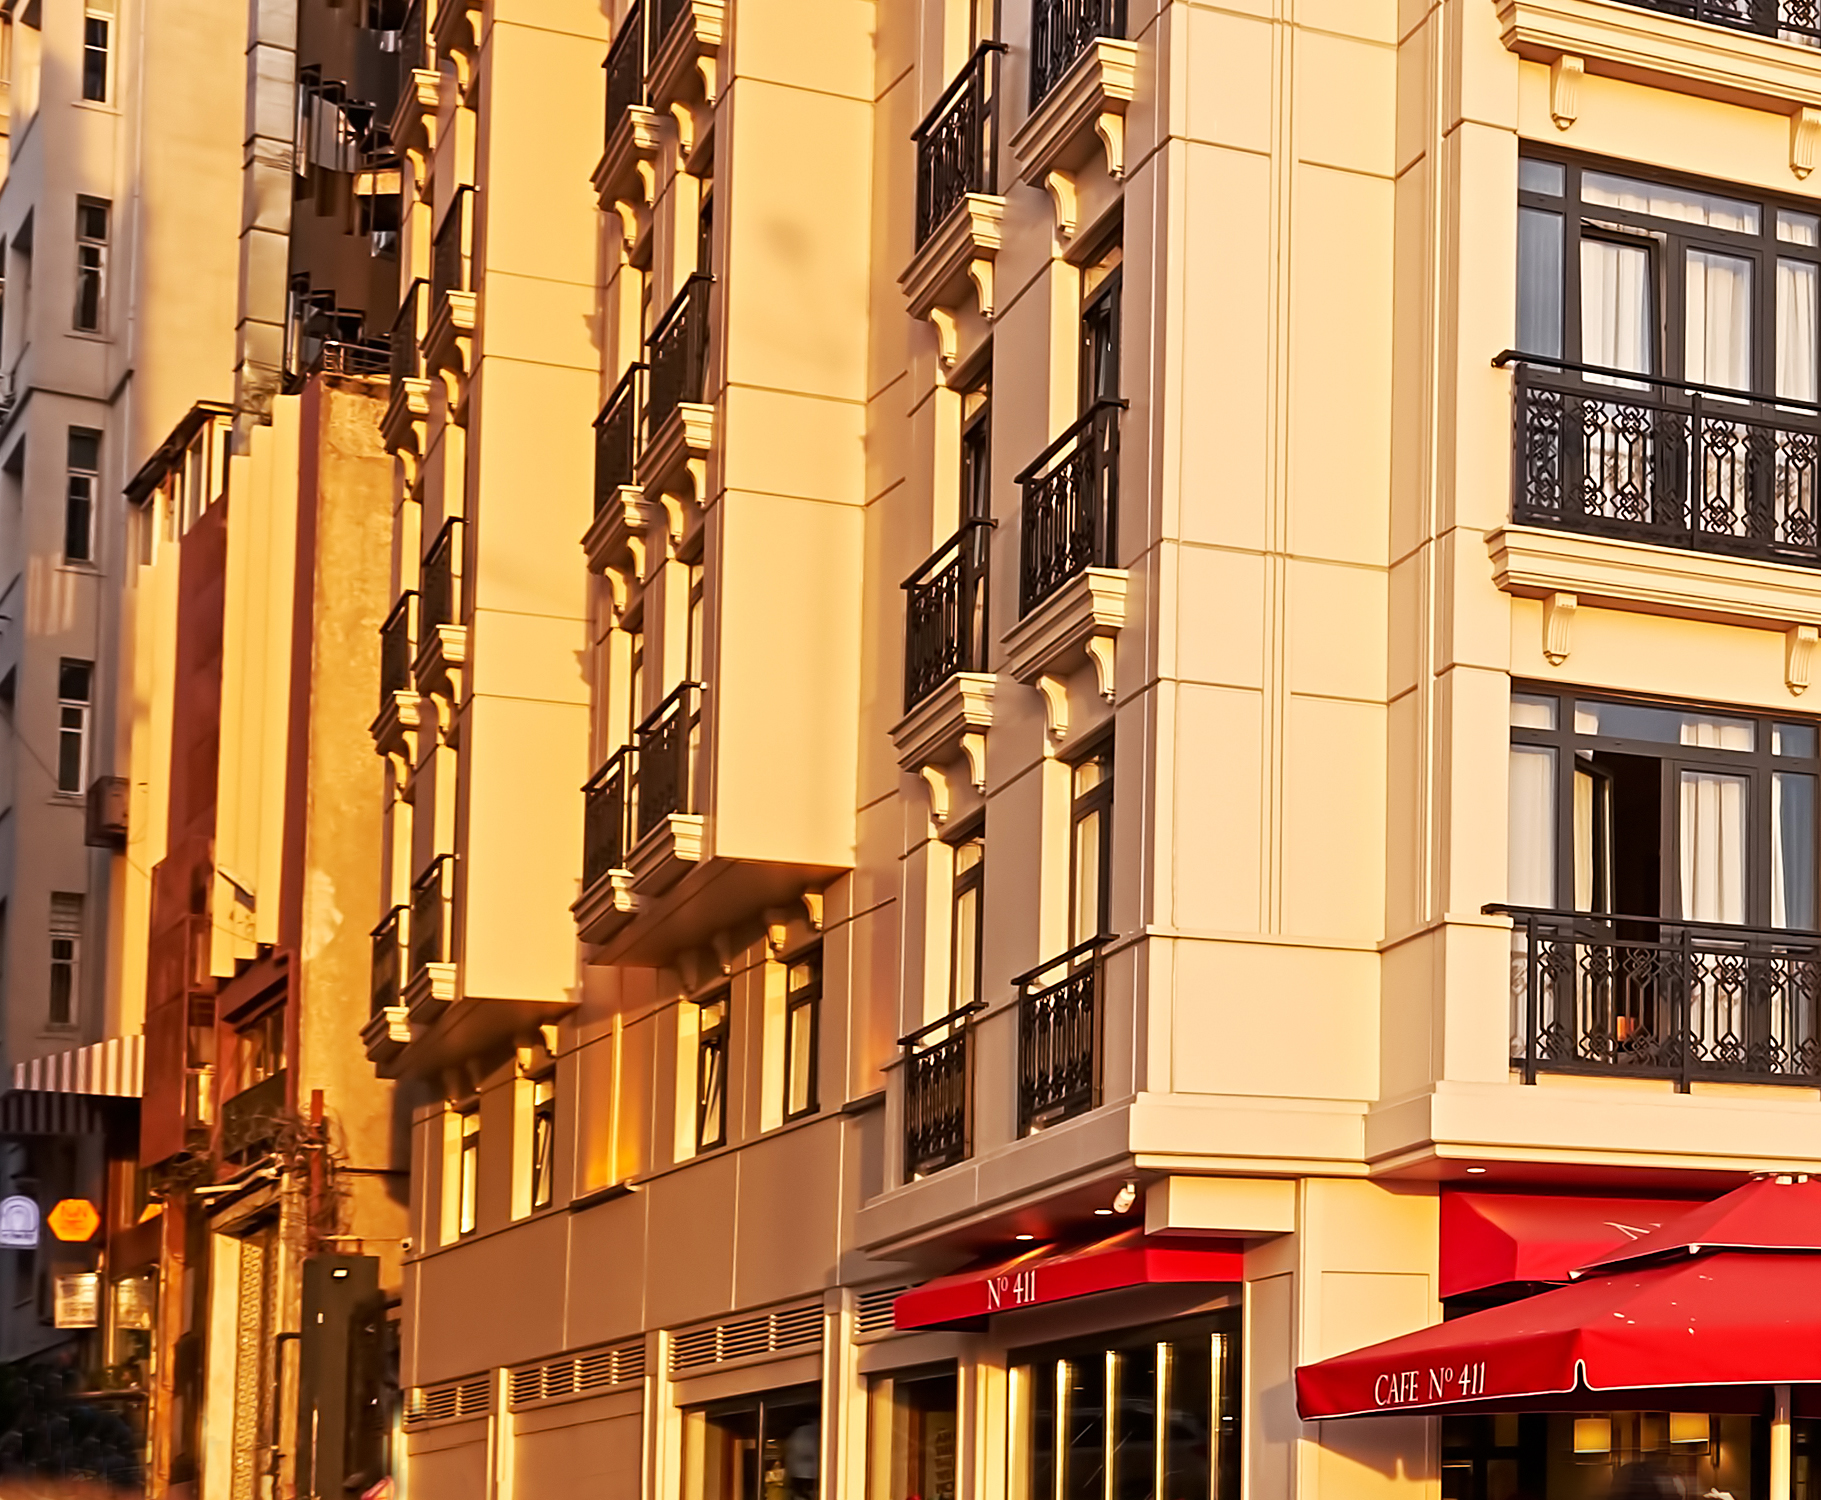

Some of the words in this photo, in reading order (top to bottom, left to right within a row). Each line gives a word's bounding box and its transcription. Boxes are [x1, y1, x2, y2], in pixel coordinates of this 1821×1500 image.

[1013, 1270, 1036, 1304] 411
[1374, 1370, 1420, 1406] CAFE
[1458, 1361, 1485, 1396] 411
